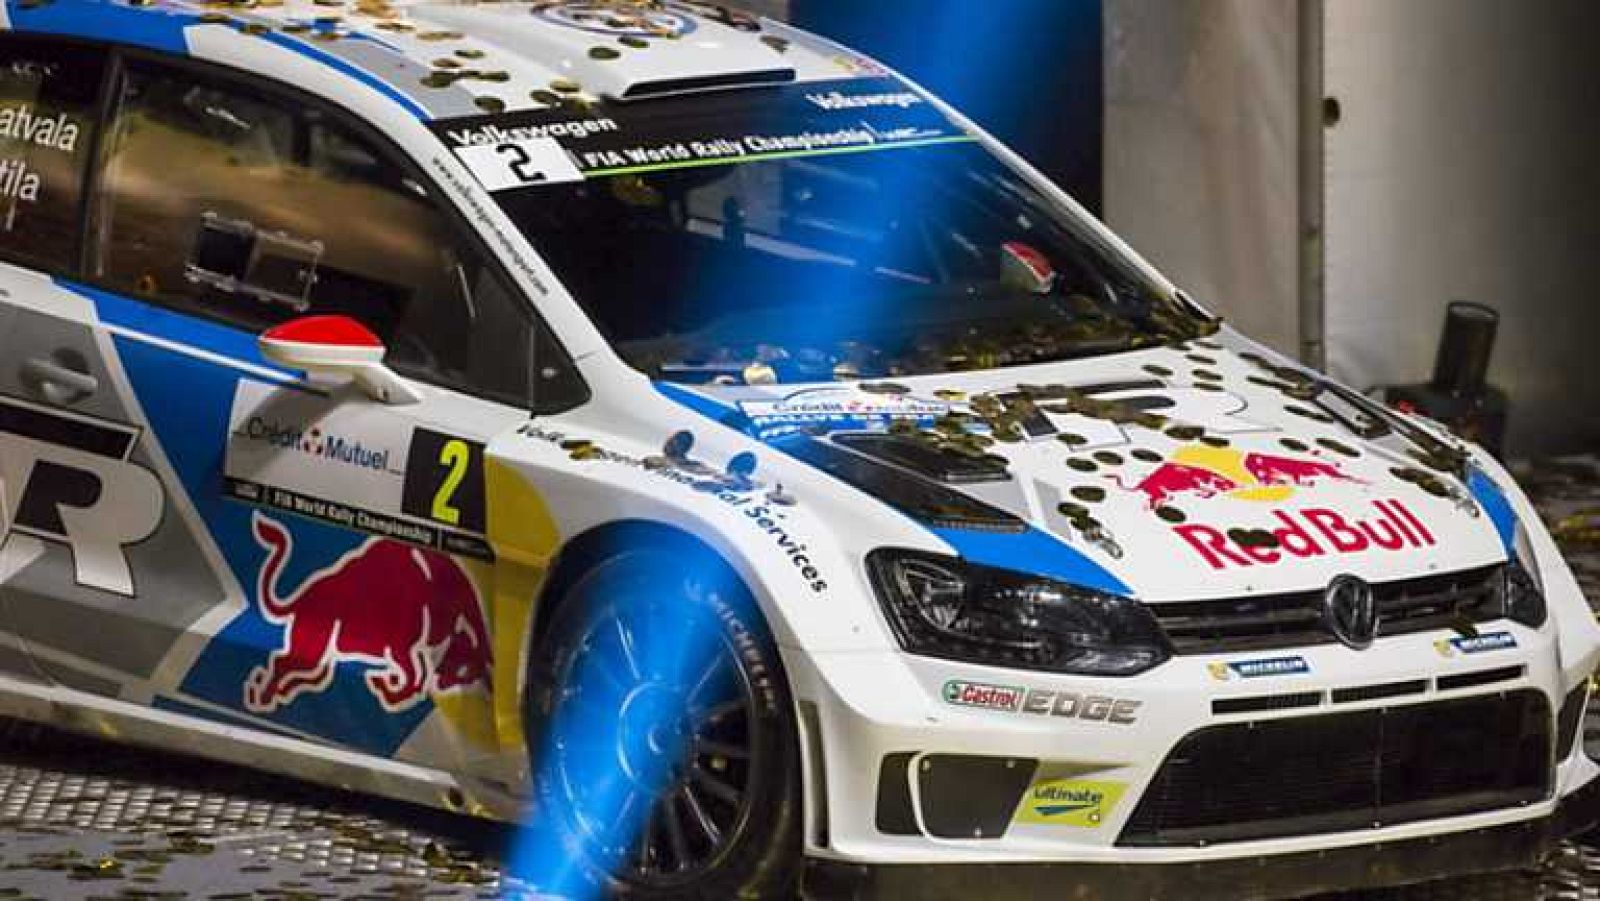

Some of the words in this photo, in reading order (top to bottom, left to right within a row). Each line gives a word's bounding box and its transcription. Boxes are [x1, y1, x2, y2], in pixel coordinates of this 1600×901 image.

[446, 117, 619, 145] Volkswagen
[584, 151, 627, 167] FIA
[623, 143, 690, 163] World
[689, 138, 746, 157] Rally
[743, 127, 874, 151] Championship
[496, 143, 547, 182] 2
[325, 435, 389, 470] Mutuel
[432, 439, 470, 524] 2
[745, 504, 828, 594] Services
[1172, 508, 1326, 569] Red
[1300, 499, 1437, 553] Bull
[1239, 658, 1306, 674] MICHELIN
[962, 686, 1022, 706] Castrol
[1022, 689, 1145, 725] EDGE
[1033, 784, 1105, 805] ultimate
